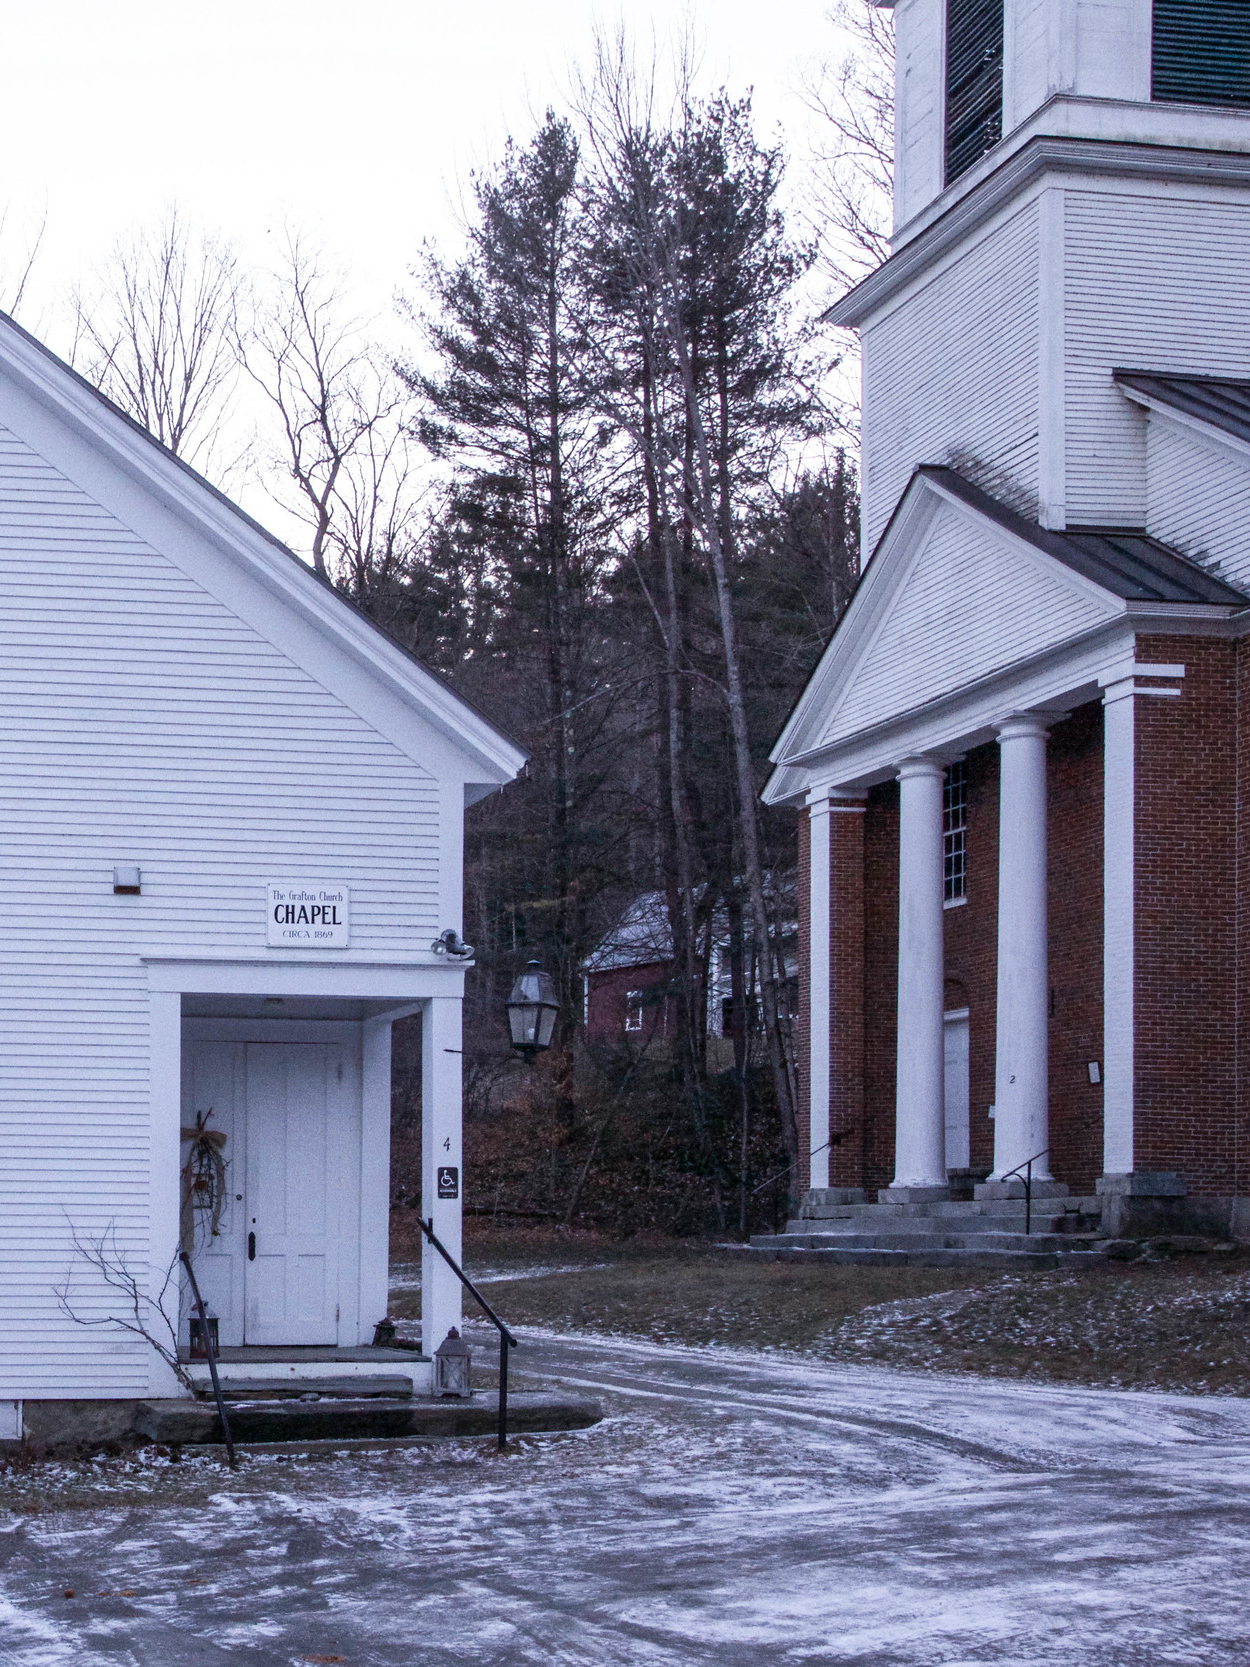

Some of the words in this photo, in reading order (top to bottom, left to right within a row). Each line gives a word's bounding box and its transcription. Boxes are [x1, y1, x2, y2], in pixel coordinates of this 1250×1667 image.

[273, 890, 285, 900] The
[289, 890, 316, 901] Grafton
[319, 891, 343, 902] Church
[274, 904, 342, 925] CHAPEL
[282, 930, 310, 938] CIRCA
[1010, 1075, 1016, 1084] 2
[443, 1137, 451, 1152] 4
